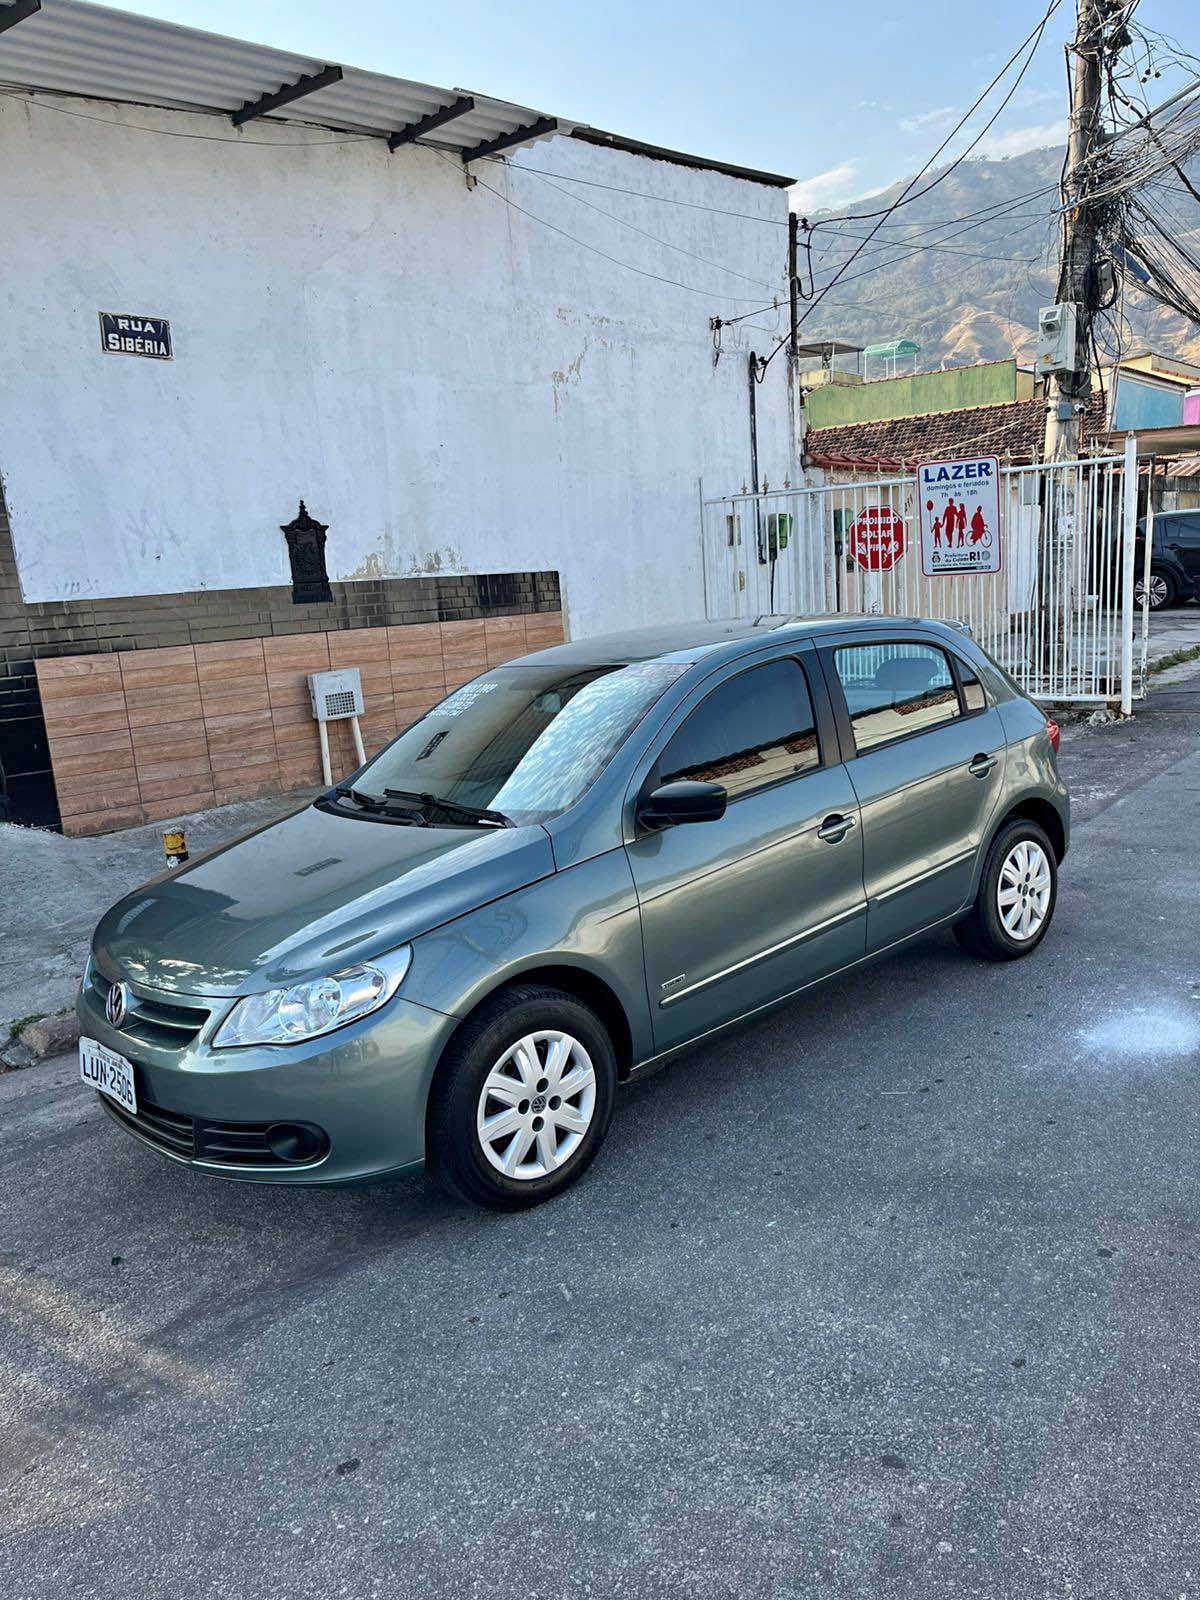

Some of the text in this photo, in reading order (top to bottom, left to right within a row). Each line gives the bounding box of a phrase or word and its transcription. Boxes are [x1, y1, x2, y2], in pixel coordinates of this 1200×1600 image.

[118, 318, 155, 333] RUA
[108, 333, 167, 355] SIBÉRIA
[924, 462, 991, 482] LAZER
[927, 483, 956, 491] domingos
[963, 480, 989, 488] feriados
